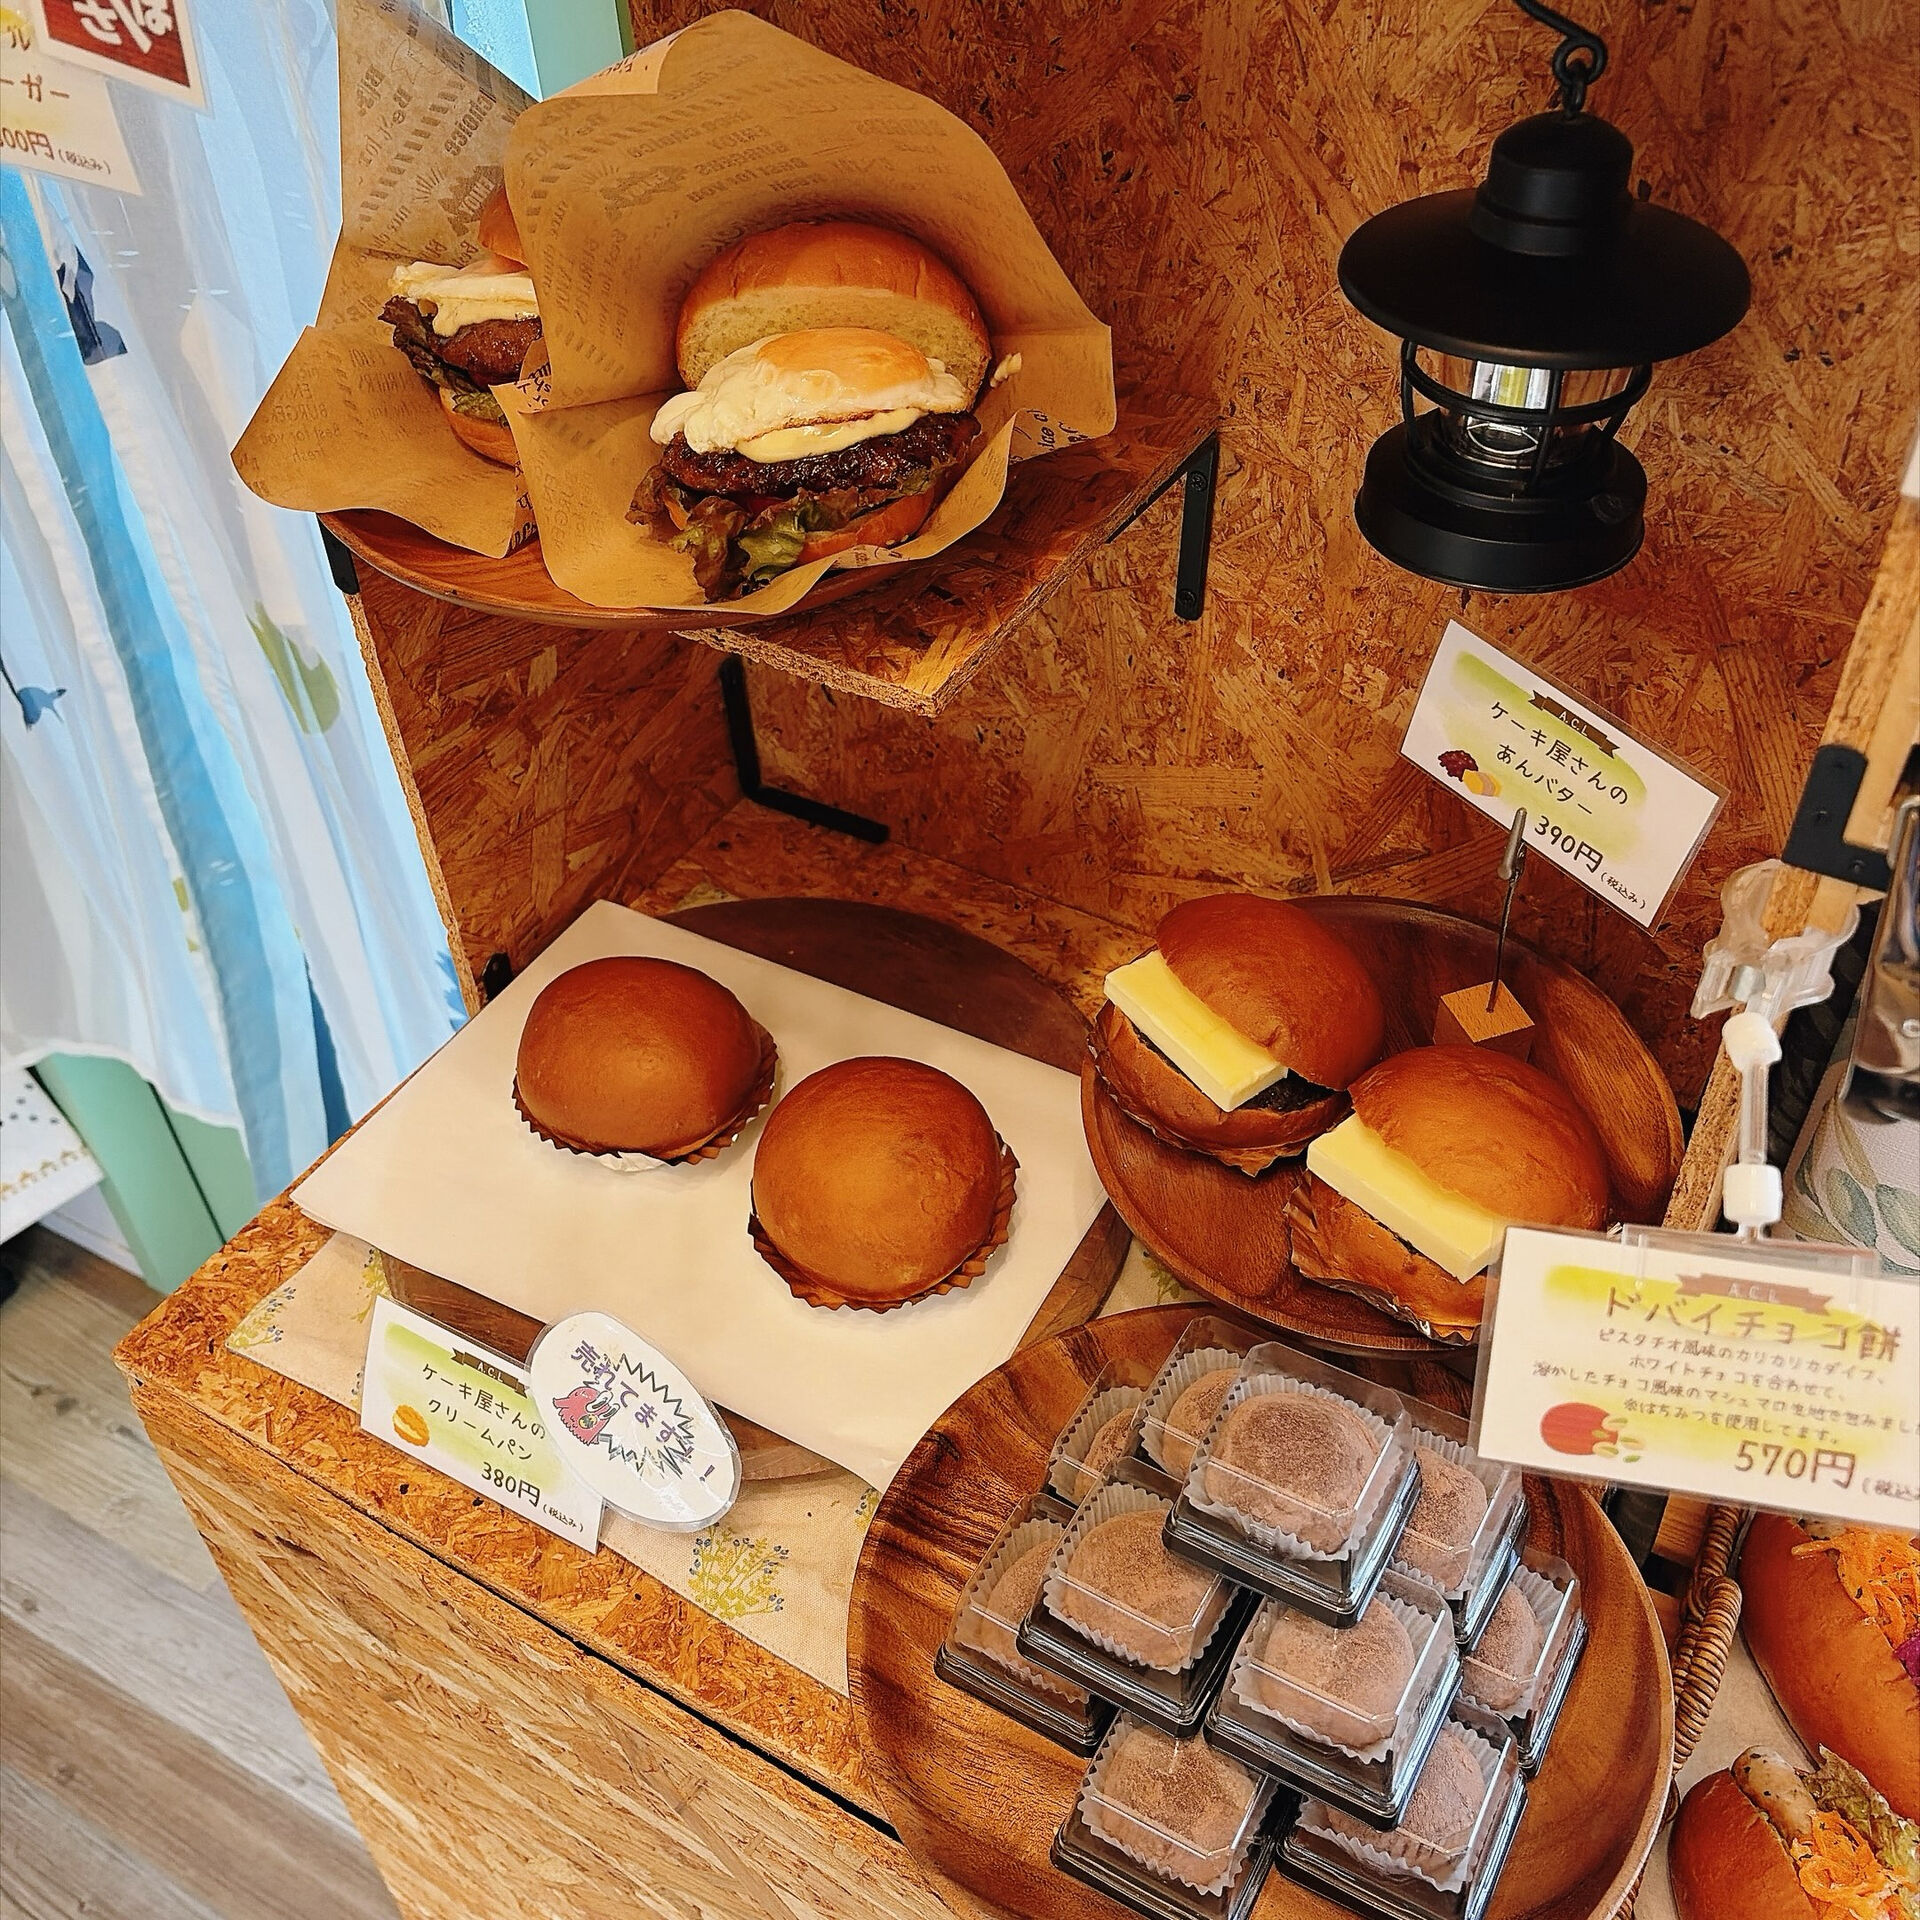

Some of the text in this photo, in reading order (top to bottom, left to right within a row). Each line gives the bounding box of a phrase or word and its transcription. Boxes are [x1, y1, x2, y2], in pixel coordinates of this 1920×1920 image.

[0, 126, 55, 161] 00円
[1490, 701, 1629, 806] ケーキ屋さんの
[1558, 710, 1588, 737] A.C.L
[1496, 742, 1593, 816] あんバター
[1533, 815, 1646, 910] 390円 (税込み)
[1606, 1285, 1902, 1364] ドバイチョコ餅
[422, 1363, 546, 1440] ケーキ屋さんの
[428, 1398, 533, 1461] クリームパン
[1532, 1360, 1920, 1436] 溶かしたチョコ風味のマシュマロ生地で包みまし
[481, 1461, 541, 1508] 380円
[1734, 1439, 1920, 1502] 570円 (税込
